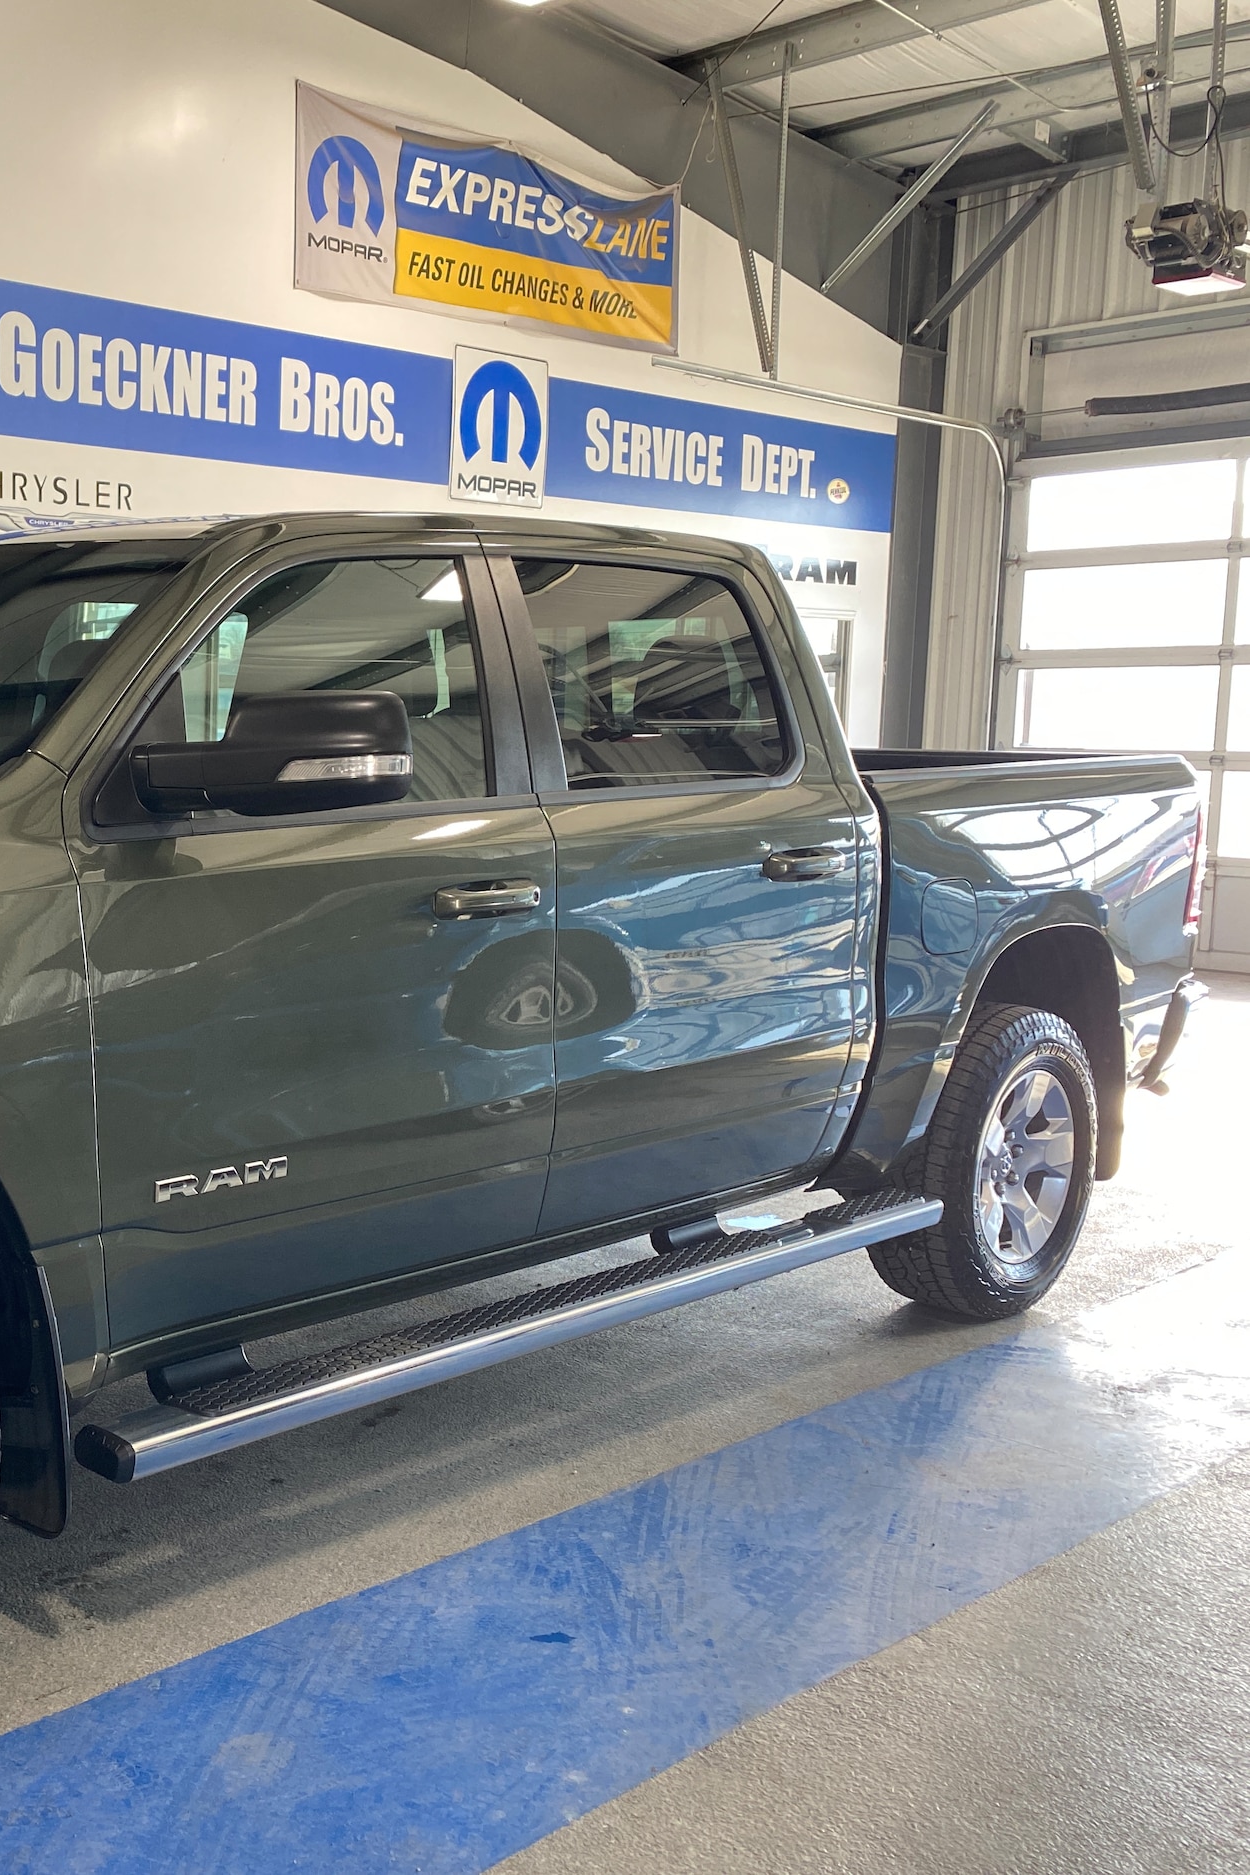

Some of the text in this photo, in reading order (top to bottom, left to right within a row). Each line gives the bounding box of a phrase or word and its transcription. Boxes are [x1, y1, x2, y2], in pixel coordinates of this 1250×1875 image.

[308, 232, 382, 262] MOPAR
[408, 251, 456, 283] FAST
[458, 262, 485, 290] OIL
[491, 268, 569, 306] CHANGES
[572, 286, 584, 310] &
[279, 356, 404, 447] BROS.
[585, 407, 816, 499] SERVICE DEPT.
[458, 472, 536, 498] MOPAR
[767, 553, 857, 585] RAM
[154, 1155, 288, 1204] RAM
